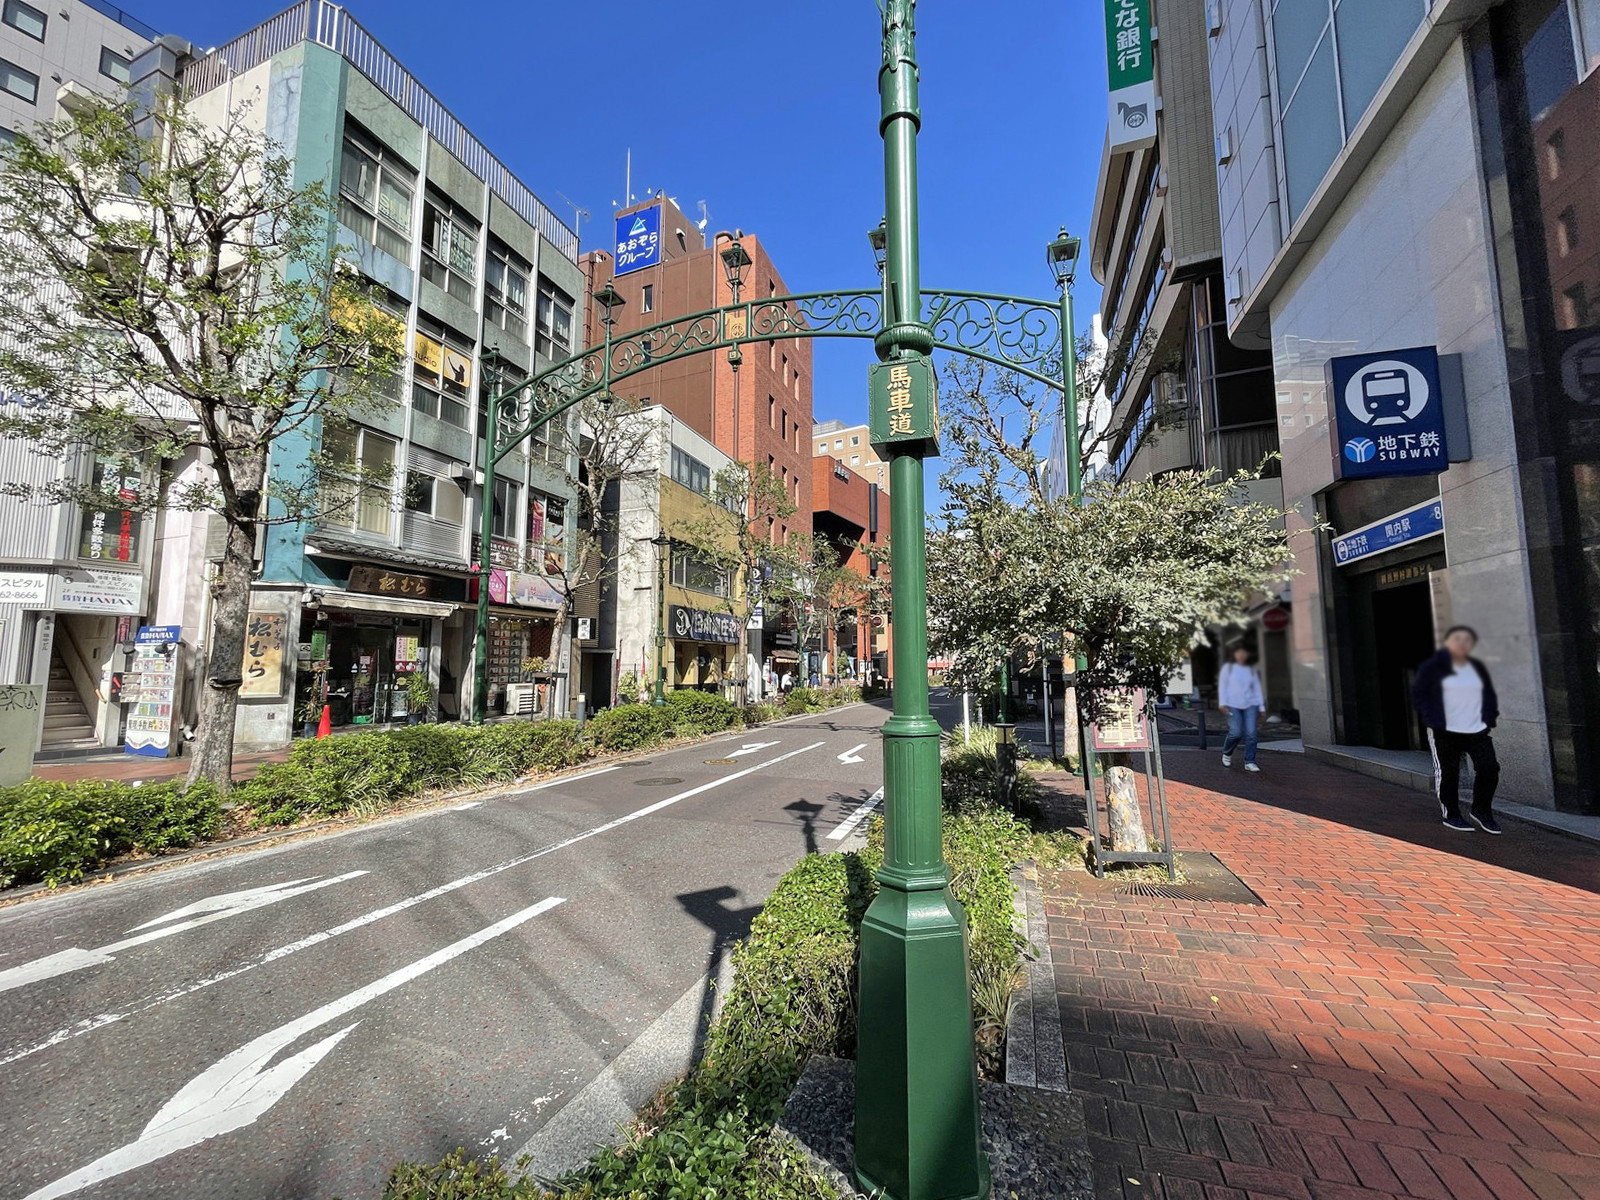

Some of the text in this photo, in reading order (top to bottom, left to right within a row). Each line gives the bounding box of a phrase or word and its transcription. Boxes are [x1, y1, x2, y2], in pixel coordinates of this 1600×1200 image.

[617, 231, 658, 254] あおぞら
[618, 243, 657, 267] グループ
[886, 365, 916, 436] 馬車道
[1378, 431, 1440, 451] 地下鉄
[1379, 447, 1441, 461] SUBWAY
[1433, 506, 1442, 520] 8
[1384, 517, 1412, 538] 関内駅
[0, 578, 44, 588] スピタル
[378, 572, 427, 595] 松むら
[0, 591, 38, 599] 62-8666
[248, 617, 272, 678] 松むら
